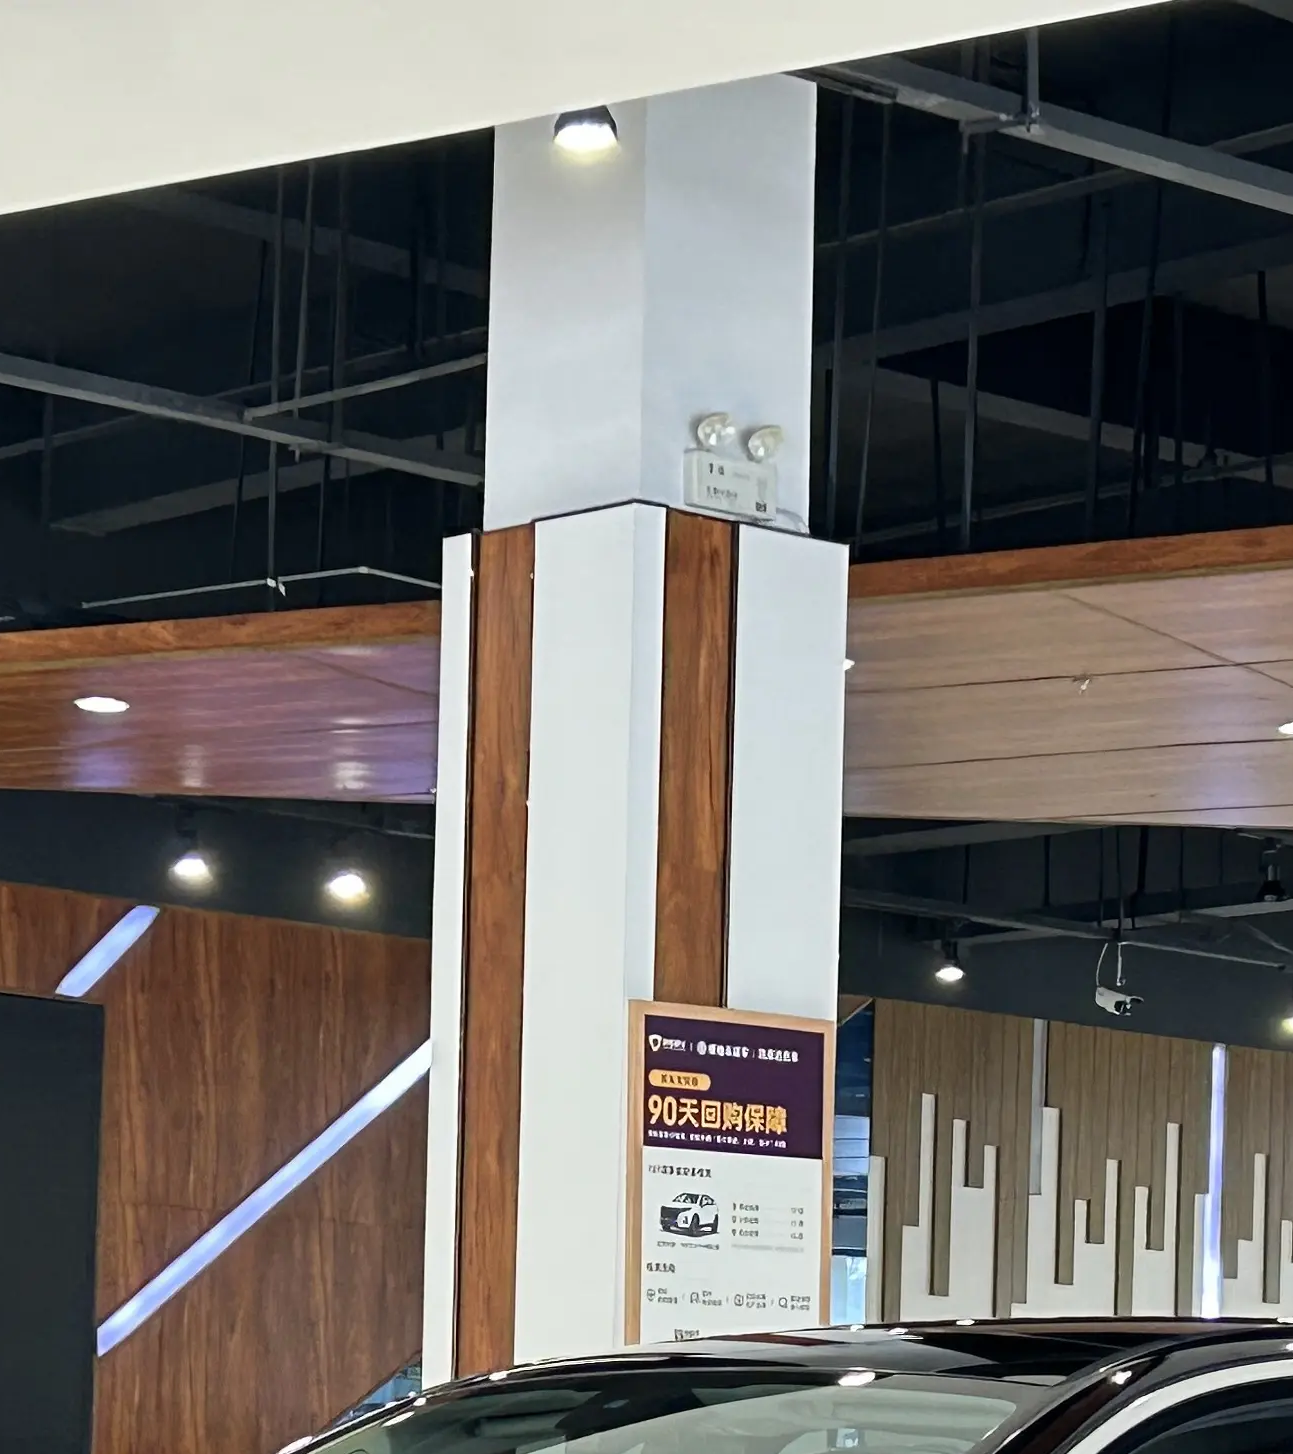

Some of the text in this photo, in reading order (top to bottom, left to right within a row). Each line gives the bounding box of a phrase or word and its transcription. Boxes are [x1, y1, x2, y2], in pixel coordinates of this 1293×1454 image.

[648, 1095, 787, 1135] 90天回购保障
